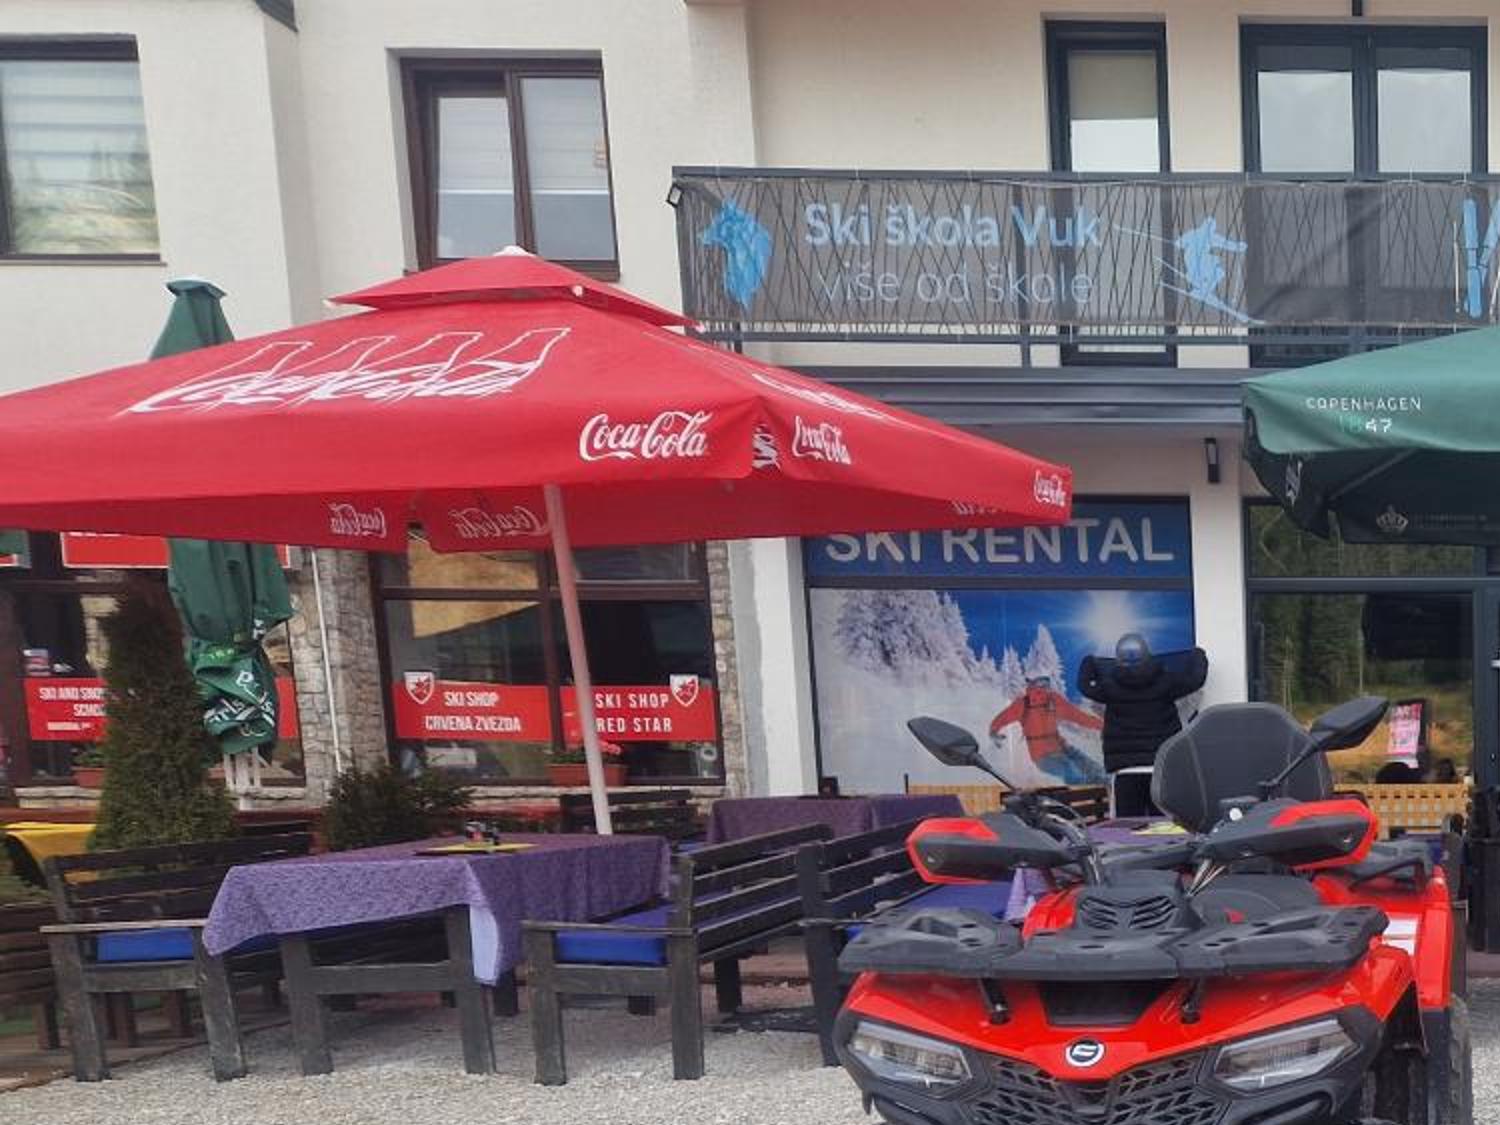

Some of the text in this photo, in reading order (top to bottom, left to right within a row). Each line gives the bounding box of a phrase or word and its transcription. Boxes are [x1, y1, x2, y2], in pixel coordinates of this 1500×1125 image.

[805, 203, 1101, 247] Ski škola Vuk
[817, 262, 1092, 303] više od škole
[1306, 396, 1421, 412] COPENHAGEN
[580, 411, 713, 461] Coca-Cola
[944, 518, 1174, 563] RENTAL
[444, 691, 498, 707] SKI SHOP
[595, 694, 669, 708] SKI SHOP
[425, 715, 521, 732] CRVENA ZVEZDA
[596, 717, 672, 732] RED STAR
